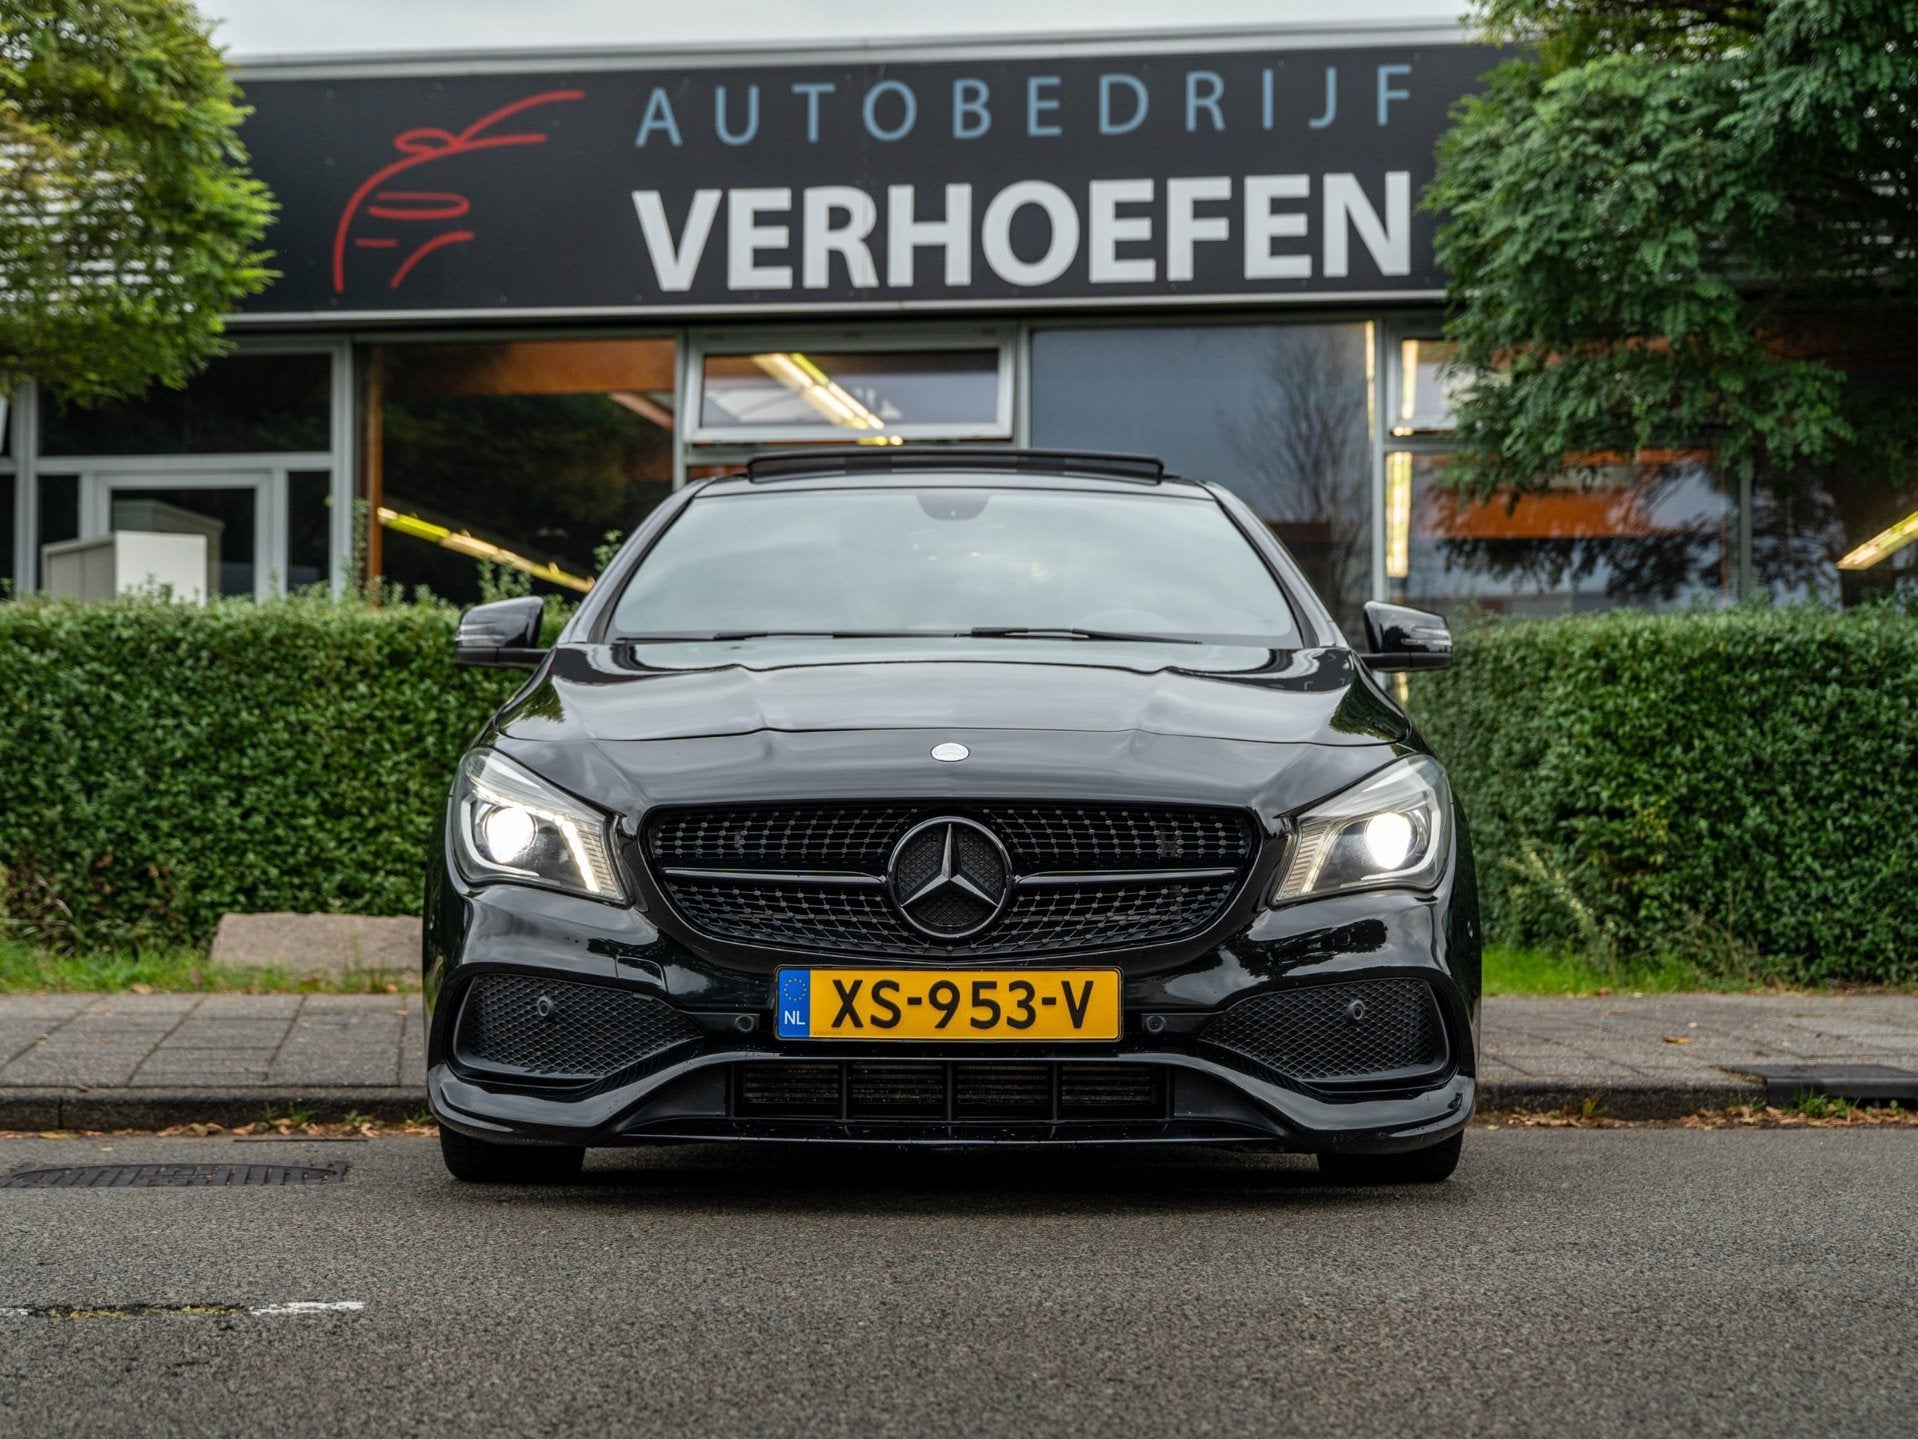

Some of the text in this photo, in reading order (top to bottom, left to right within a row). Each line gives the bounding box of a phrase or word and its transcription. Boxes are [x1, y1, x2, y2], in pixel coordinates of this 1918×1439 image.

[635, 64, 1413, 148] AUTOBEDRIJF
[632, 171, 1411, 292] VERHOEFEN
[783, 1010, 806, 1026] NL
[831, 979, 1094, 1029] XS-953-V
